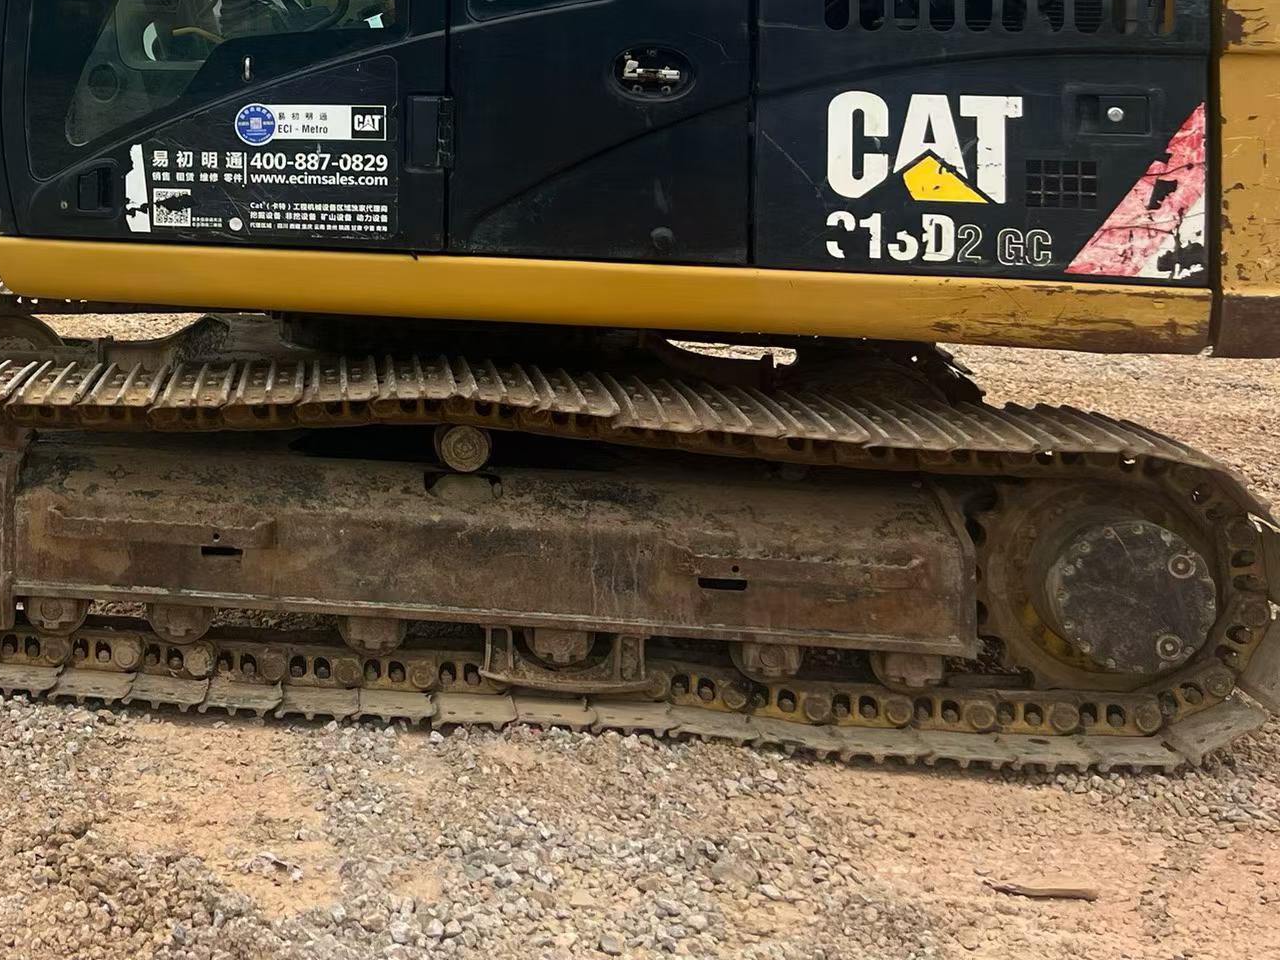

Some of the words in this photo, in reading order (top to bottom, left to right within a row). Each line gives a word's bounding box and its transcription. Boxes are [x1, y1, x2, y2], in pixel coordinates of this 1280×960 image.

[278, 124, 292, 133] ECI
[302, 124, 328, 134] Metro
[354, 114, 382, 131] CAT
[826, 90, 1023, 204] CAT
[152, 150, 243, 169] 易初明通
[250, 152, 388, 172] 400-887-0829
[223, 173, 243, 183] 零件
[250, 172, 388, 186] www.ecimsales.com
[996, 228, 1052, 267] GC
